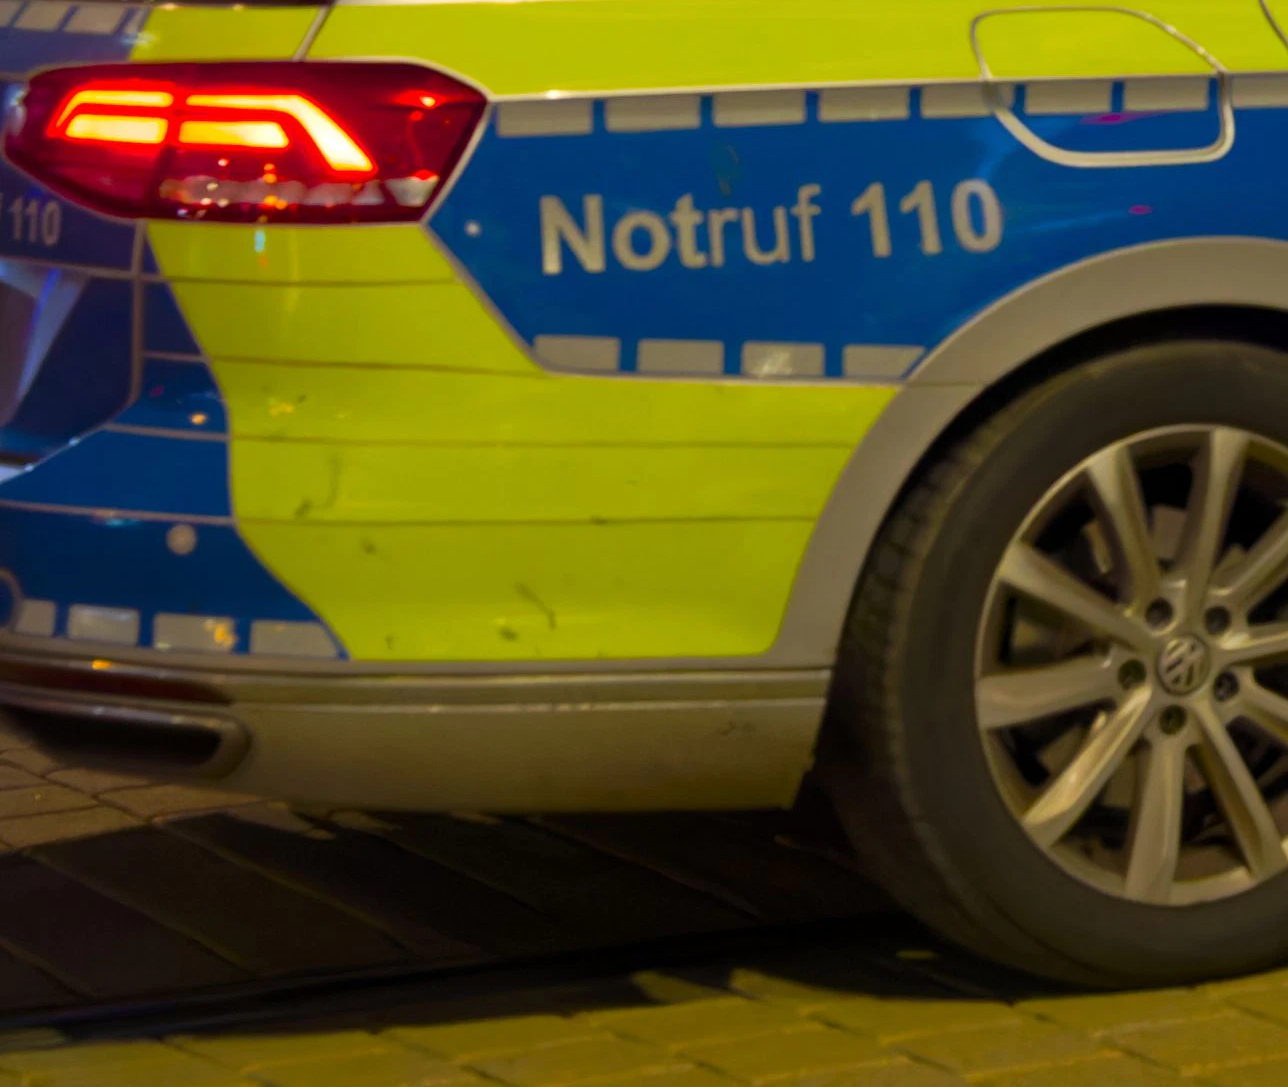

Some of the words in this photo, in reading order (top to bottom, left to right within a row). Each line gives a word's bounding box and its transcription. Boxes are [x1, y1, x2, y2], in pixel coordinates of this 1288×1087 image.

[8, 195, 62, 247] 110
[538, 183, 822, 275] Notruf
[851, 178, 1004, 259] 110
